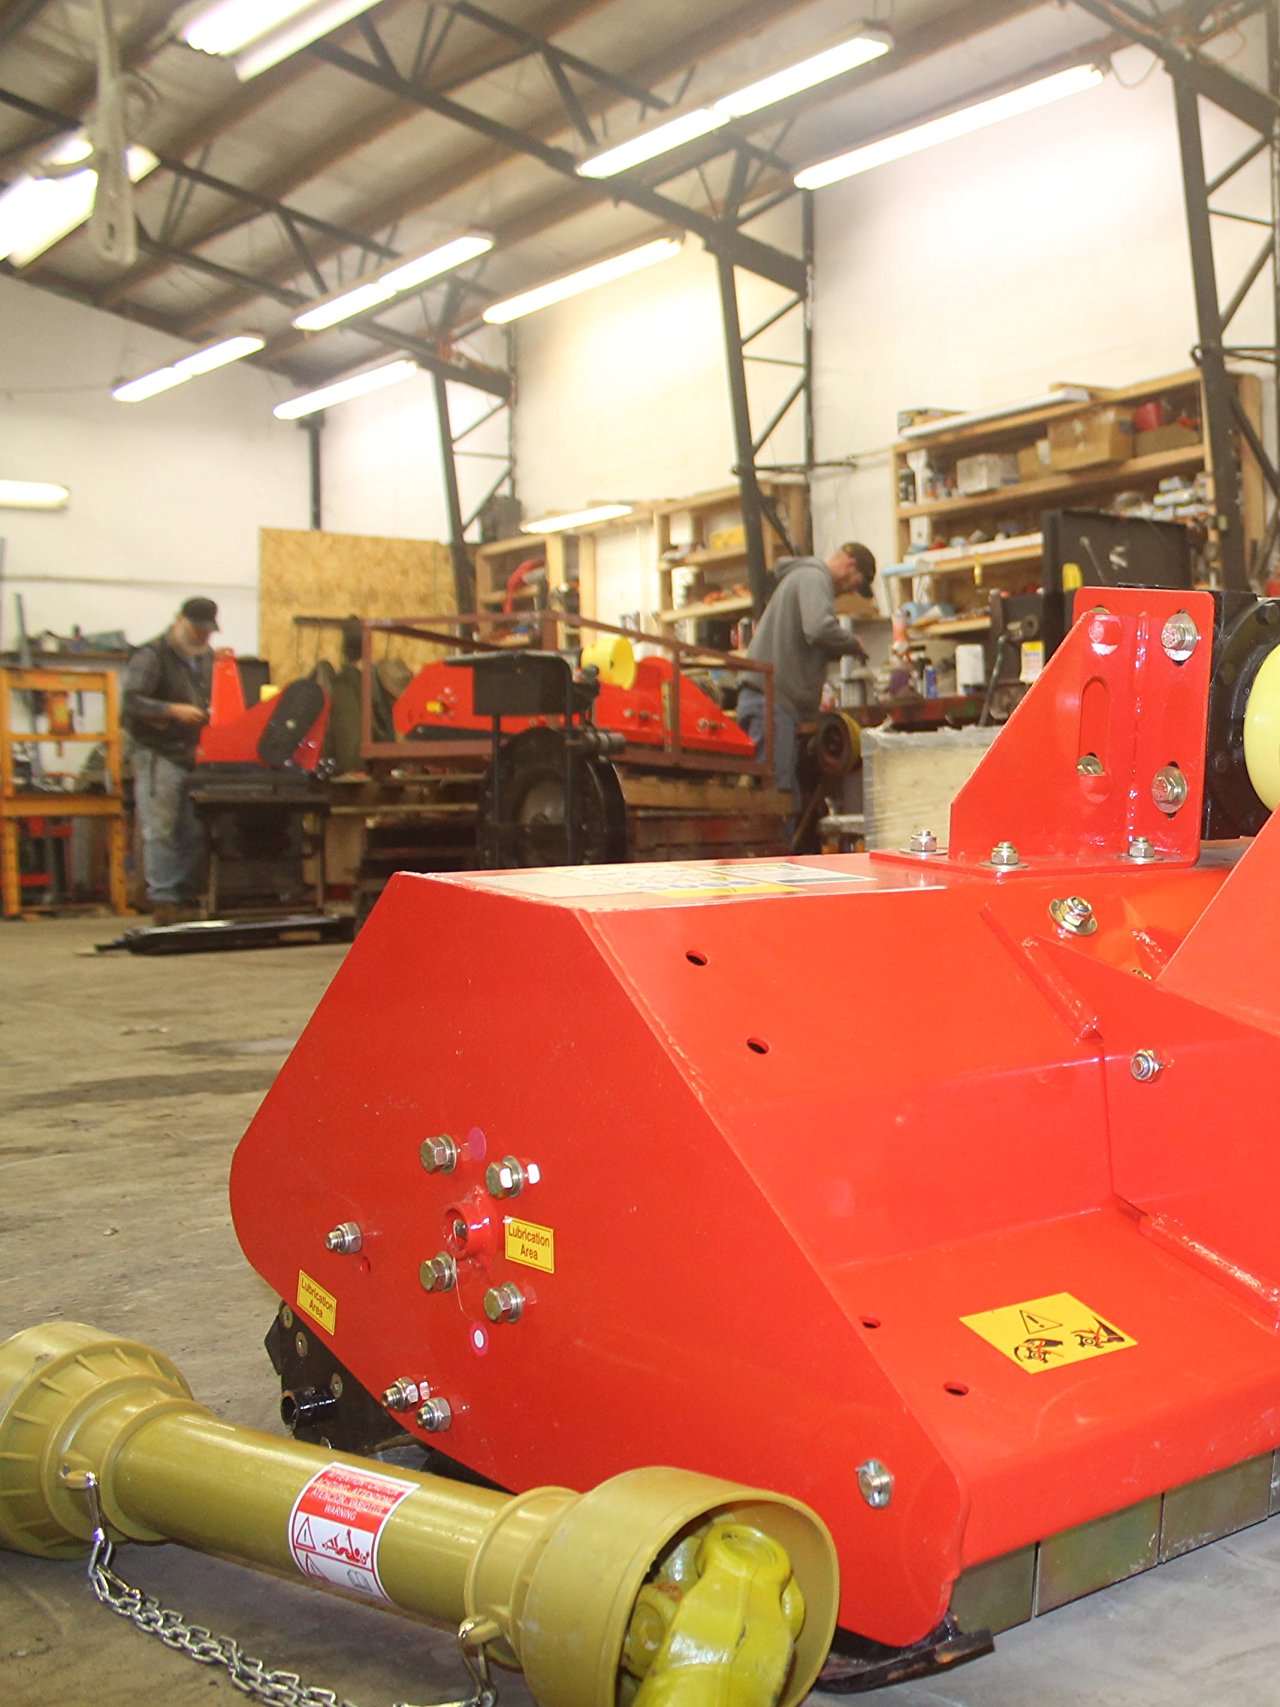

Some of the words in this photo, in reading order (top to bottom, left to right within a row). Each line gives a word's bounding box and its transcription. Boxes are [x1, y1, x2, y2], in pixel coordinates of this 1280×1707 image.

[508, 1224, 550, 1248] Lubrication
[520, 1243, 538, 1260] Area
[301, 1277, 334, 1313] Lubrication
[309, 1299, 323, 1318] Area
[324, 1504, 358, 1521] WARNING
